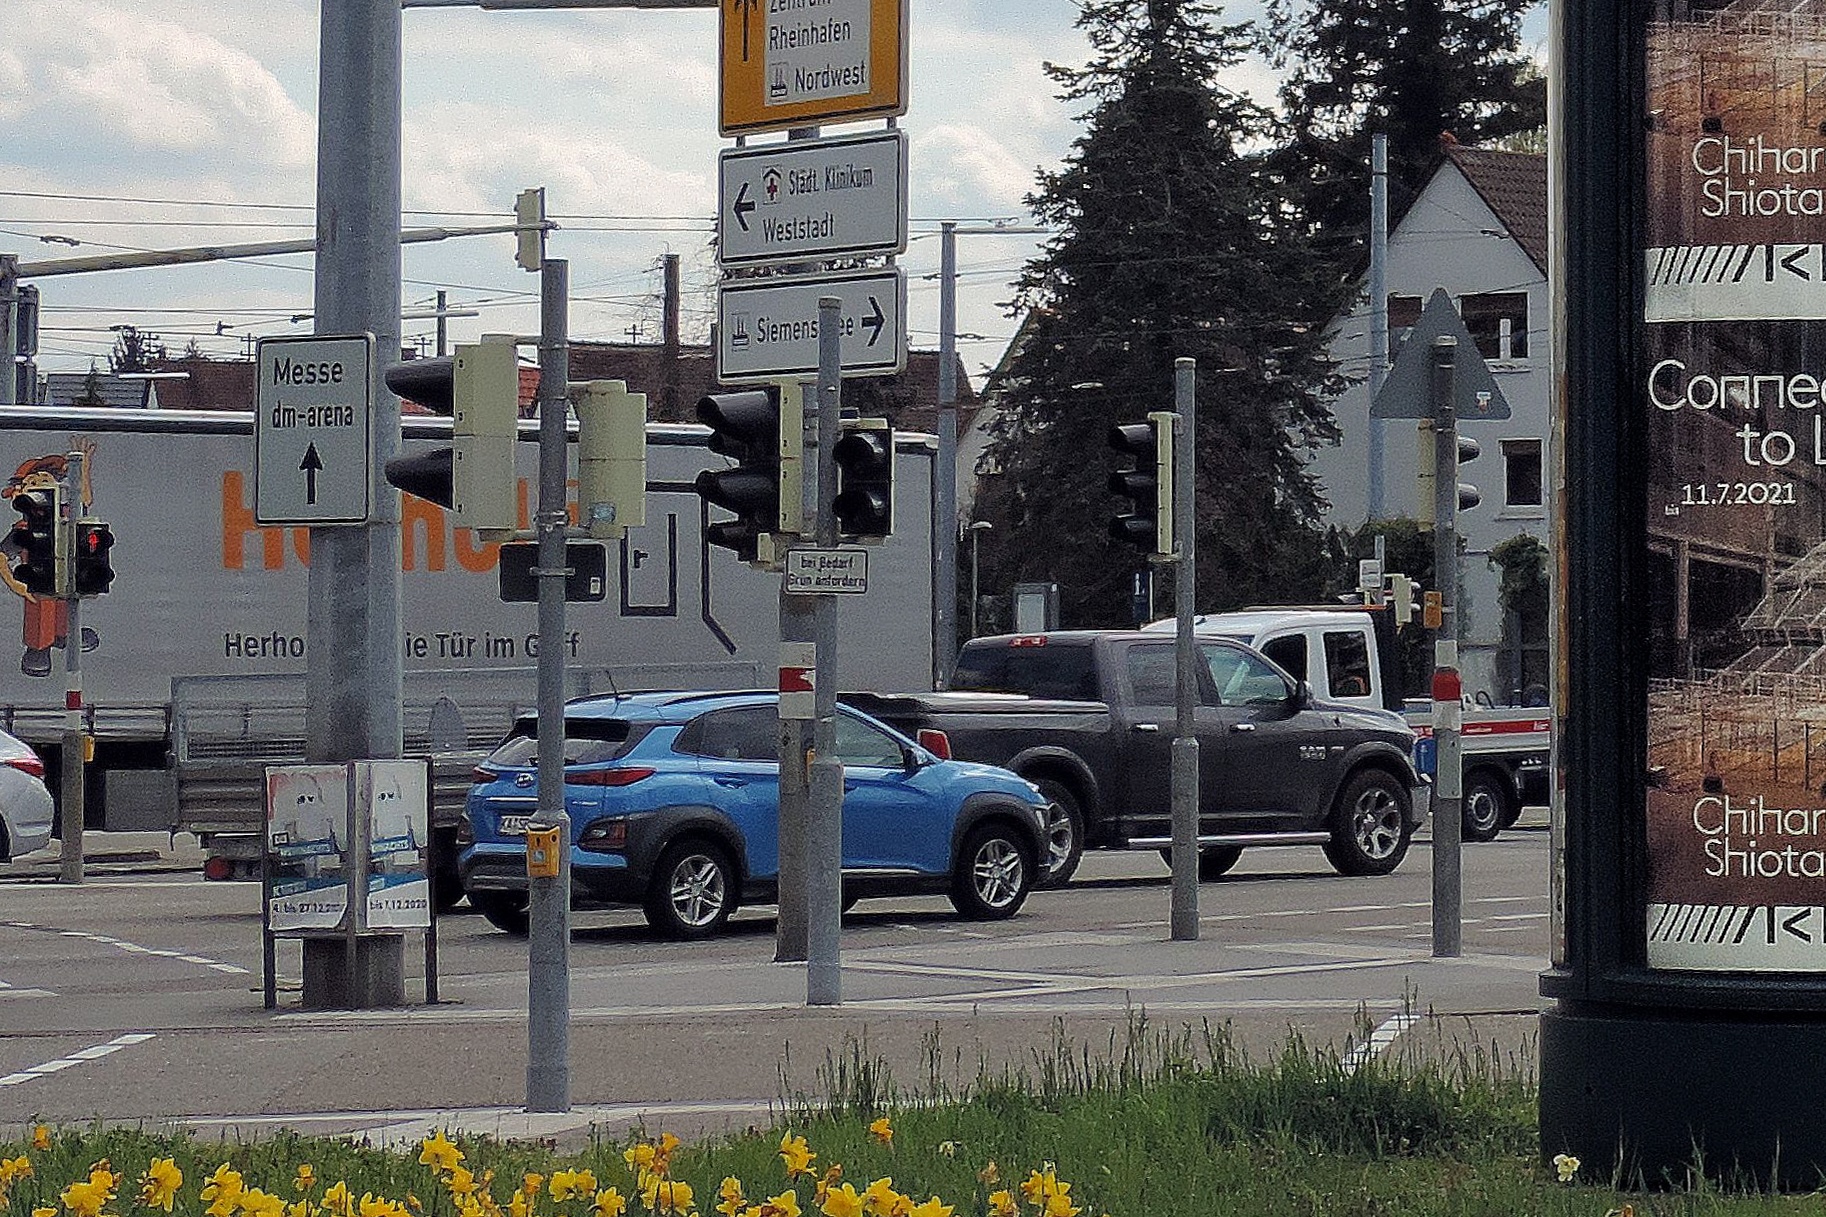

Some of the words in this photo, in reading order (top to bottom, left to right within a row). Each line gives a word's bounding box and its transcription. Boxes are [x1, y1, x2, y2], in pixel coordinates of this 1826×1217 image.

[769, 20, 850, 51] Rheinhafen
[794, 61, 866, 94] Nordwest
[825, 164, 873, 192] Klinikum
[1701, 179, 1824, 217] Shiota
[763, 212, 835, 244] Weststadt
[273, 359, 342, 385] Messe
[272, 400, 353, 428] dm-arena
[1737, 423, 1796, 466] to
[1681, 483, 1797, 505] 11.7.2021
[435, 632, 476, 658] Tür
[485, 632, 515, 658] im
[1704, 838, 1825, 878] Shiota
